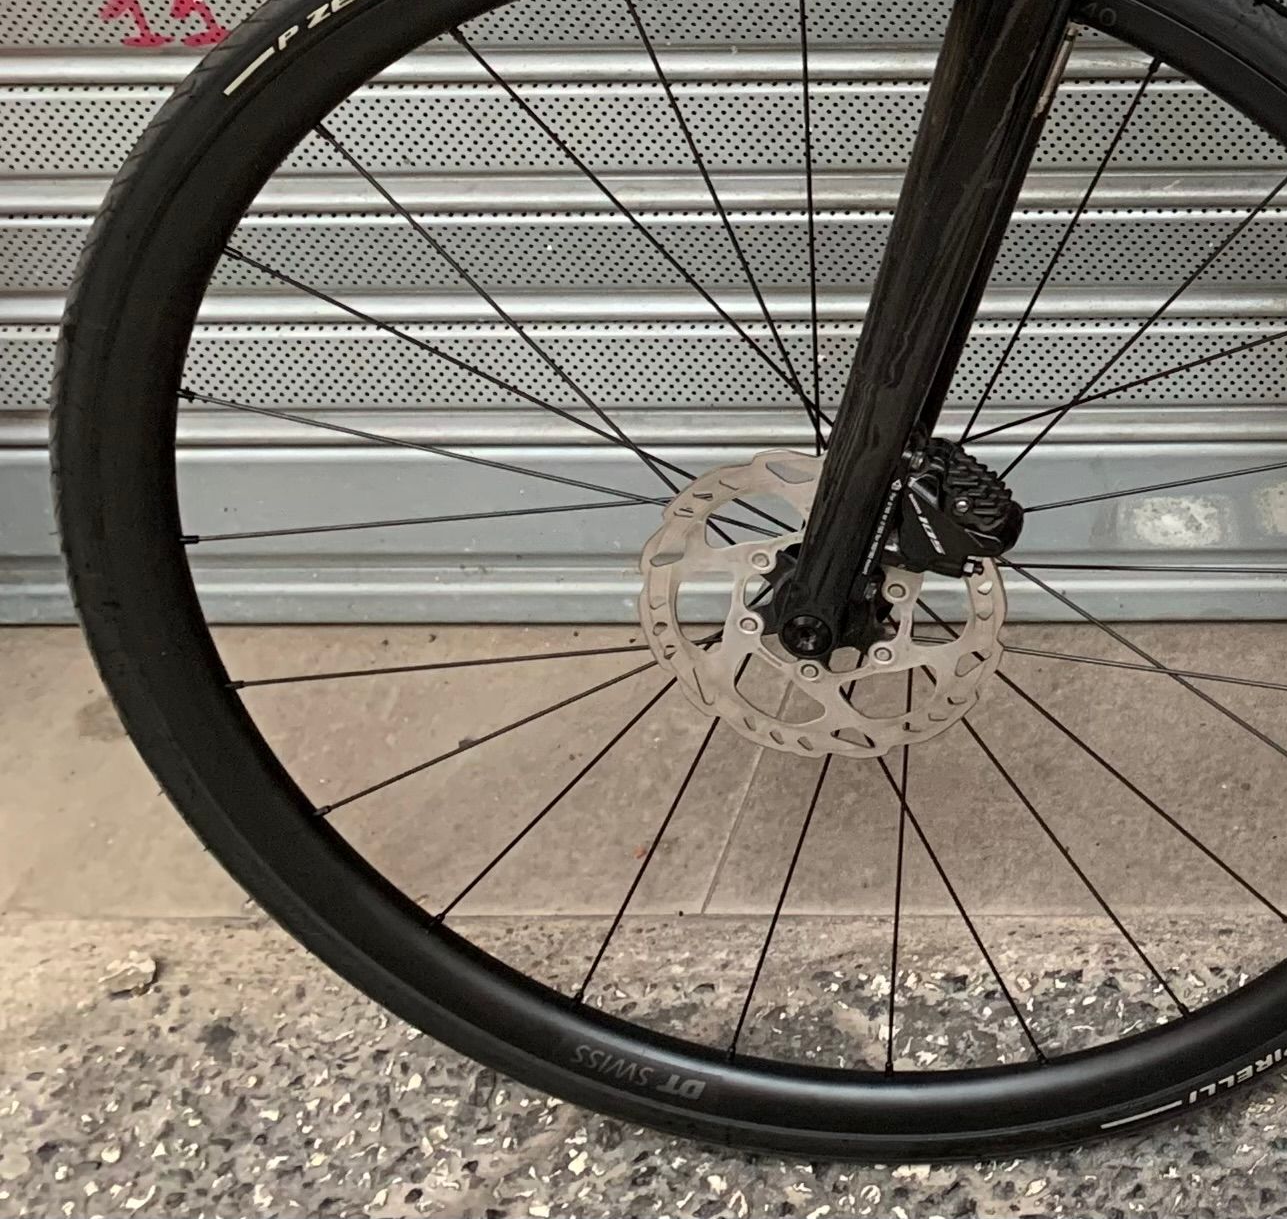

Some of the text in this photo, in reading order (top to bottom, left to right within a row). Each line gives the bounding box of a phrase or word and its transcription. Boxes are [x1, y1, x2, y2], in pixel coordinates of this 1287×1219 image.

[278, 25, 299, 51] P
[570, 1044, 707, 1101] DT SWISS
